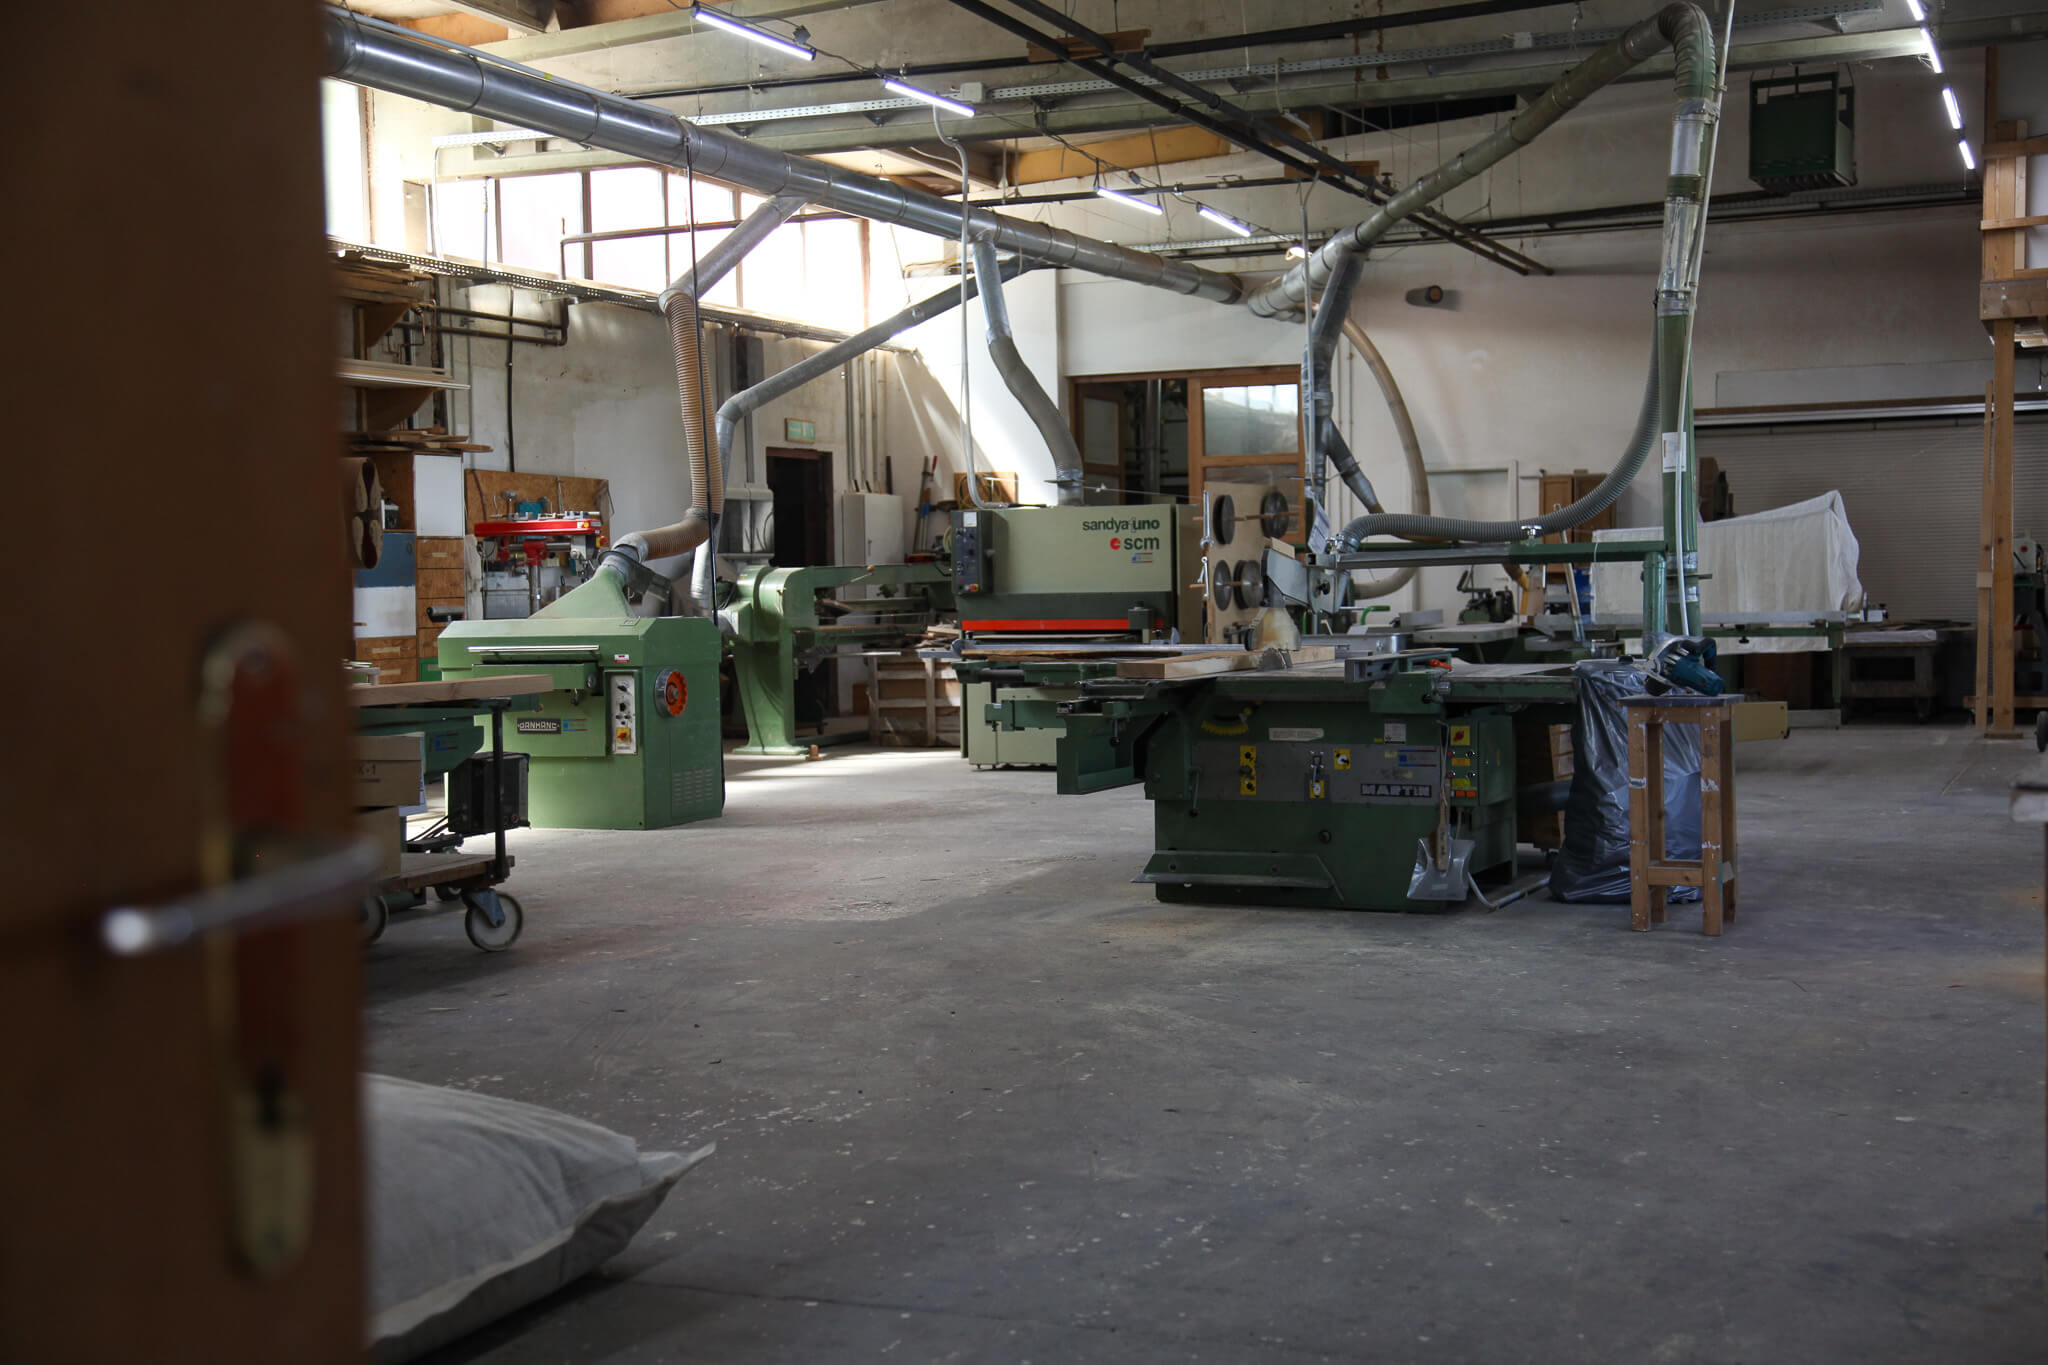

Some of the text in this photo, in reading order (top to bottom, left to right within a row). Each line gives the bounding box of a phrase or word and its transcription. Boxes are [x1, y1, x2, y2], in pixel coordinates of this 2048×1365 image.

[1082, 517, 1160, 533] sandya uno
[1123, 537, 1160, 550] scm
[1361, 784, 1431, 797] MARTIN
